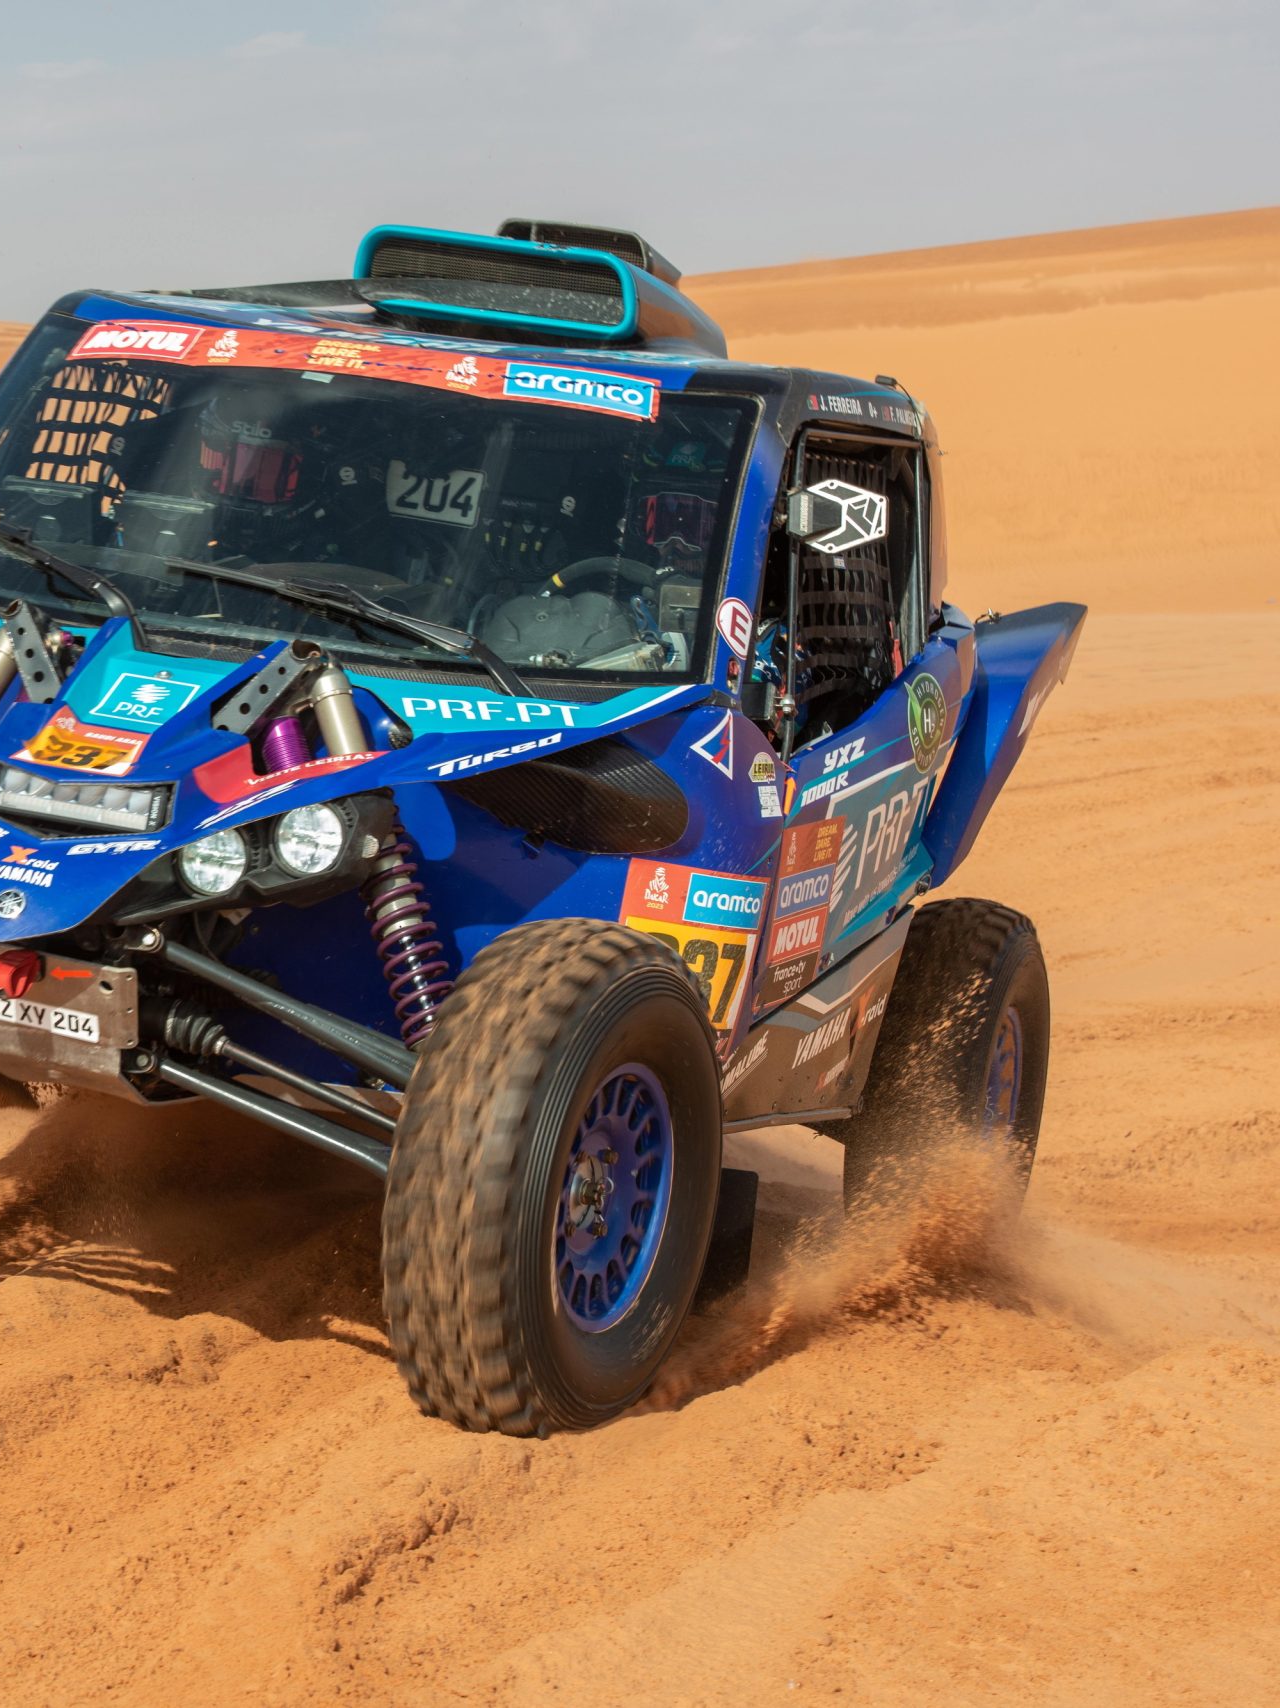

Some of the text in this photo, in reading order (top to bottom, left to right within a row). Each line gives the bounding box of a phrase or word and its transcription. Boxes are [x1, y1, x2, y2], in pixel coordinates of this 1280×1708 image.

[83, 330, 189, 352] MOTUL
[514, 371, 645, 405] aramco
[828, 395, 862, 415] FERREIRA
[396, 475, 475, 518] 204
[730, 606, 749, 648] E
[112, 701, 163, 718] PRF
[403, 697, 580, 727] PRF.PT
[427, 733, 563, 776] TURBO
[823, 736, 866, 774] YXZ
[800, 771, 849, 807] 1000R
[66, 839, 162, 856] GYTR
[646, 901, 664, 910] 2023
[693, 890, 761, 914] aramco
[780, 873, 829, 908] aramco
[773, 915, 819, 956] MOTUL
[648, 932, 747, 1023] 37
[783, 976, 803, 995] sport
[20, 1004, 46, 1025] XY
[54, 1012, 93, 1036] 204
[791, 1007, 851, 1070] YAMAHA
